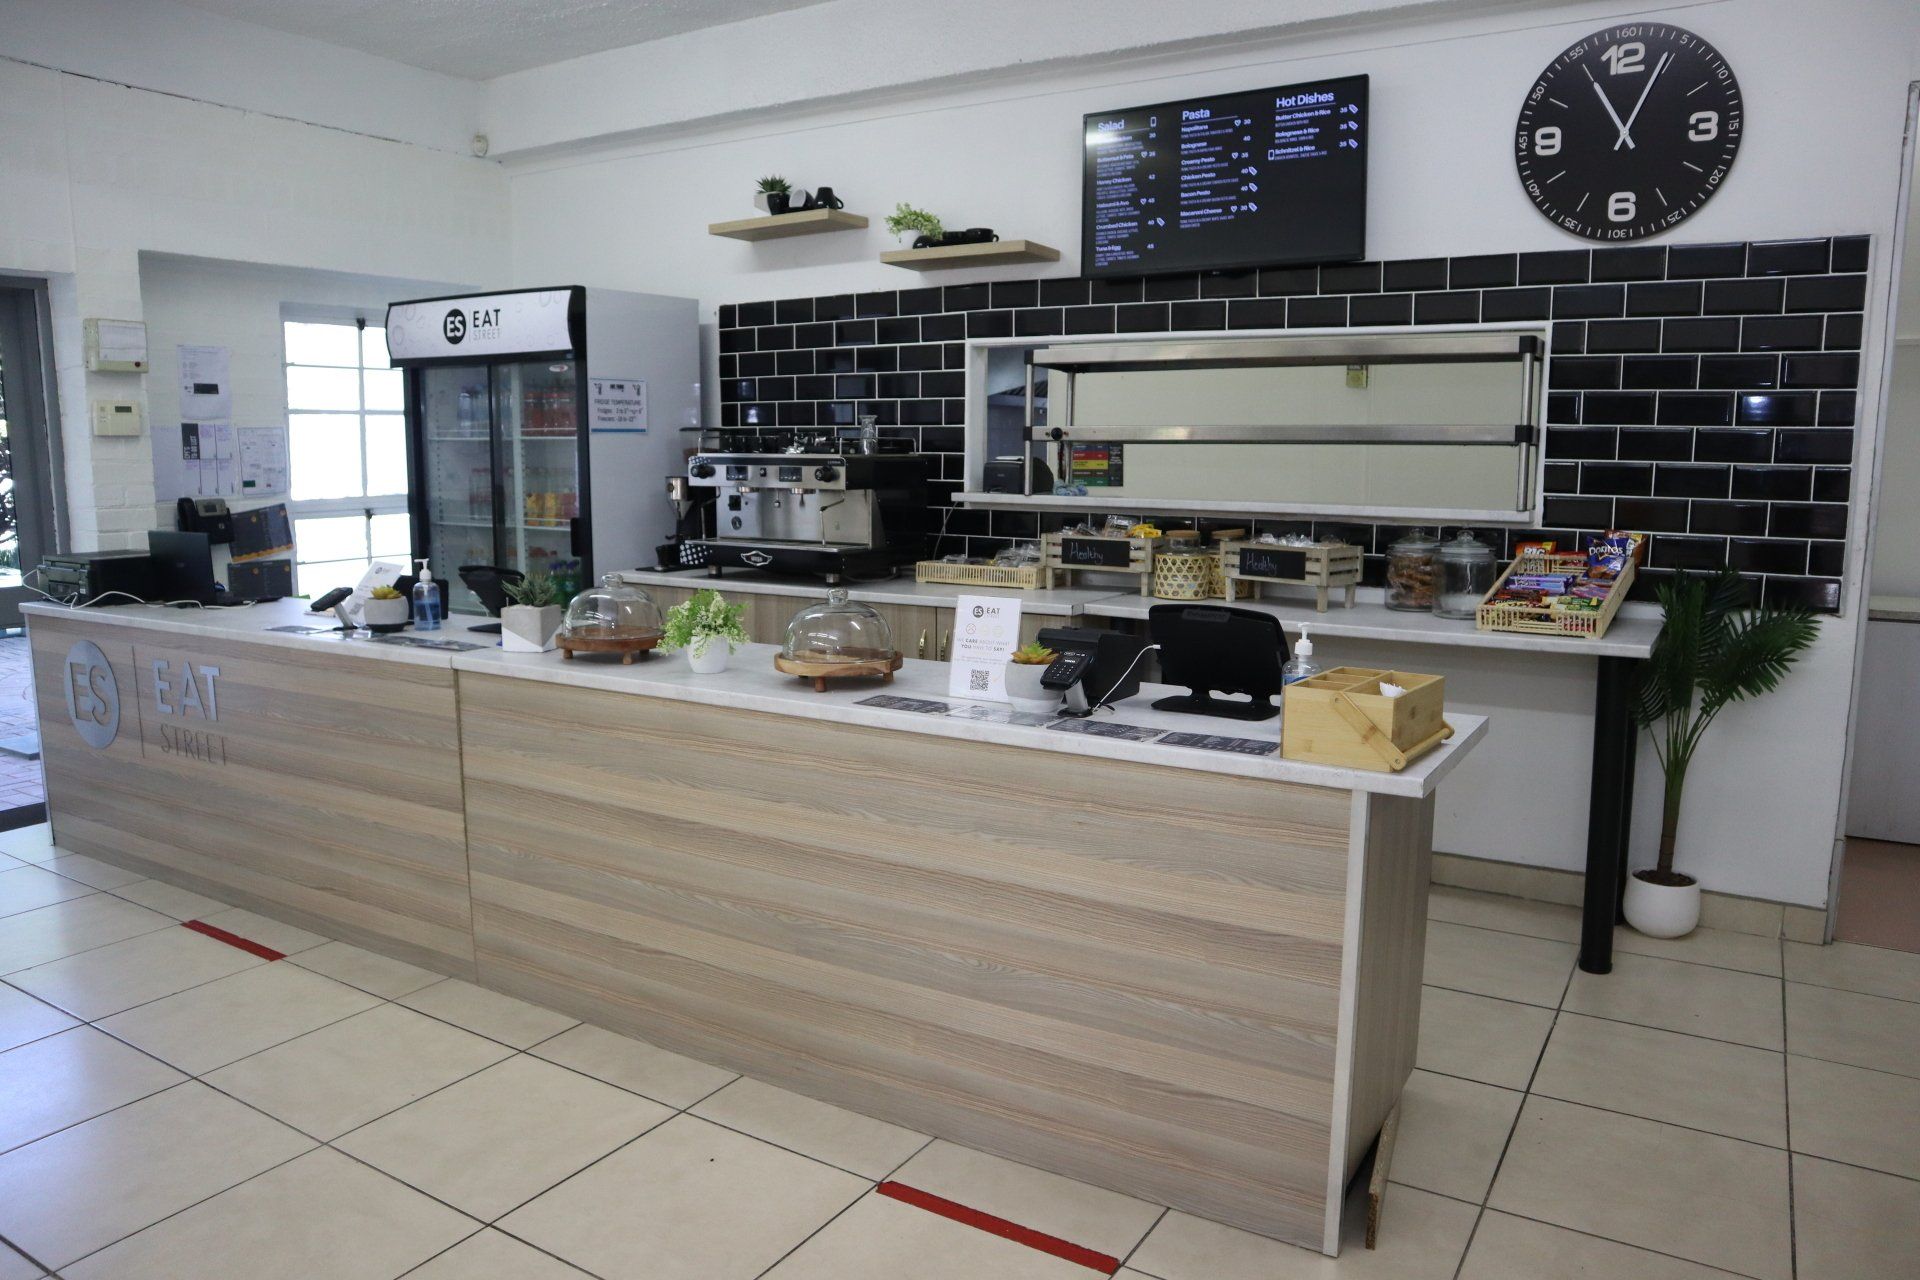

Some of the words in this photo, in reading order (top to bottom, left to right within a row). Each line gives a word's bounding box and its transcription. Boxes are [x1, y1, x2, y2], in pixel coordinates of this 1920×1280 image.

[1621, 27, 1636, 38] 60
[1680, 34, 1689, 44] 5
[1569, 47, 1584, 60] 55
[1601, 41, 1645, 76] 12
[1716, 64, 1728, 79] 10
[1276, 96, 1296, 108] Hot
[1297, 92, 1334, 105] Dishes
[1533, 86, 1545, 101] 50
[1182, 108, 1210, 121] Pasta
[1098, 119, 1125, 132] Salad
[1688, 110, 1719, 142] 3
[1729, 118, 1739, 131] 15
[1518, 135, 1528, 150] 45
[1535, 126, 1562, 156] 9
[1710, 171, 1724, 184] 20
[1607, 191, 1636, 222] 6
[1564, 217, 1578, 229] 35
[1668, 210, 1682, 224] 25
[1612, 228, 1628, 239] 30
[473, 309, 501, 328] EAT
[446, 316, 464, 338] ES
[473, 329, 501, 340] STREET
[1070, 542, 1103, 565] Healthy
[1589, 546, 1623, 555] Doritos
[70, 662, 111, 726] ES
[152, 659, 221, 722] EAT
[160, 723, 228, 766] STREET
